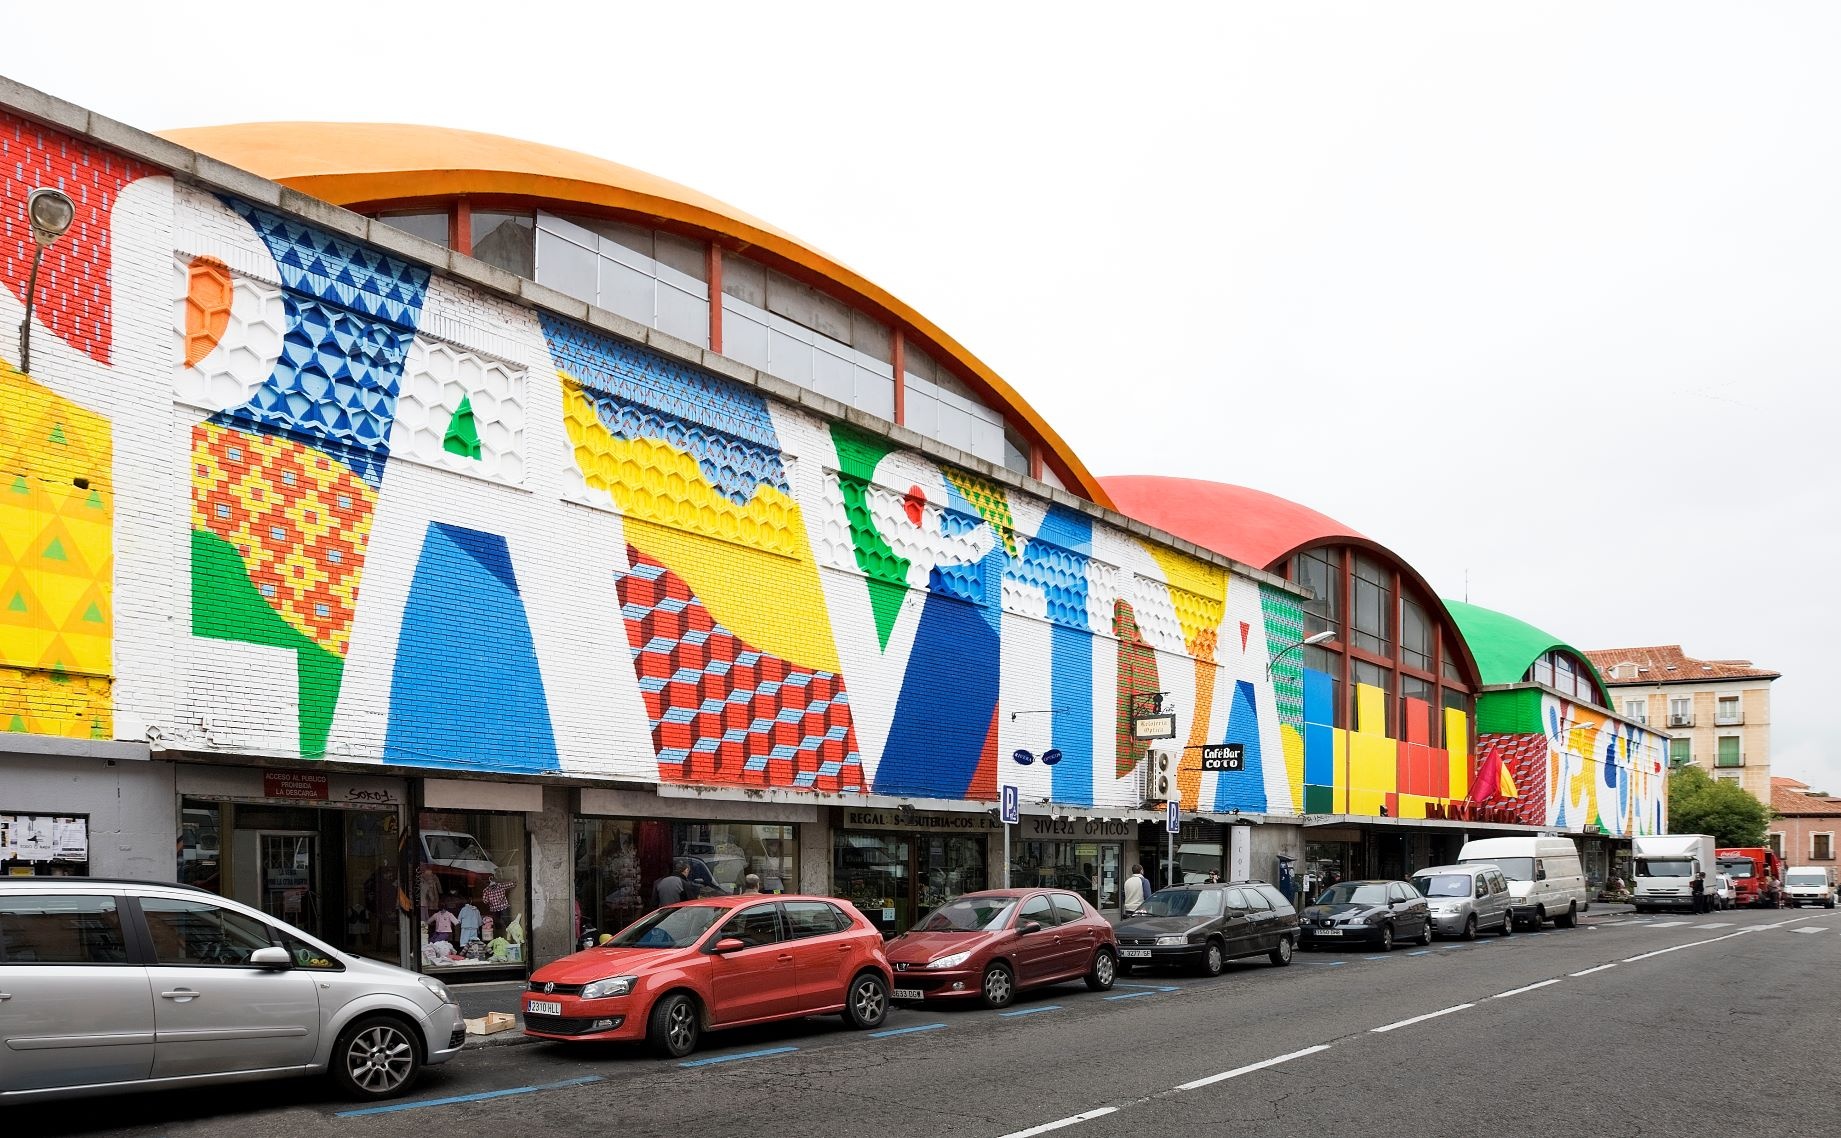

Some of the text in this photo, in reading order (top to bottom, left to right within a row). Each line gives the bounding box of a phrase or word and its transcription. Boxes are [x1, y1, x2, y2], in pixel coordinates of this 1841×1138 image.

[1014, 752, 1032, 763] RIVERA
[1223, 747, 1241, 759] Bar
[1205, 759, 1238, 769] COTO
[266, 772, 291, 781] ACCESO
[301, 775, 327, 783] PUBLICO
[281, 781, 312, 790] PROHIBIDA
[275, 788, 318, 797] LA DESCARGA
[1006, 787, 1014, 818] P
[1170, 803, 1177, 829] P
[1033, 819, 1129, 836] RIVERA OPTICOS
[531, 1002, 560, 1014] 2310 HLL
